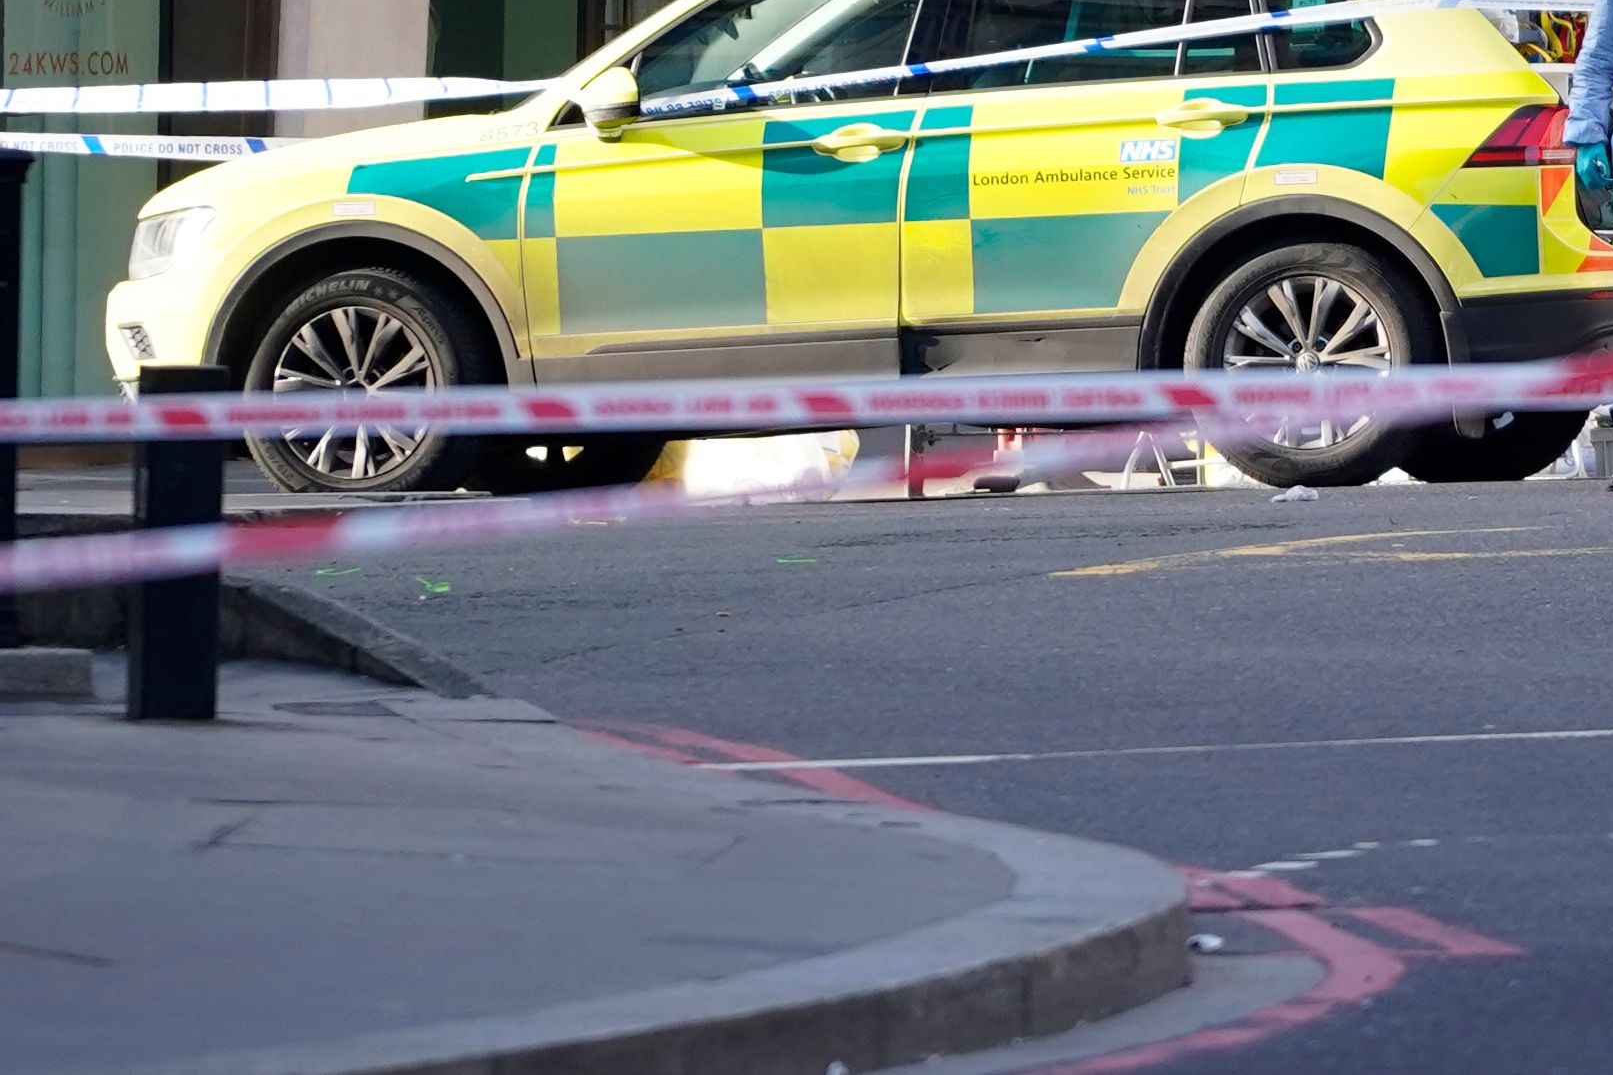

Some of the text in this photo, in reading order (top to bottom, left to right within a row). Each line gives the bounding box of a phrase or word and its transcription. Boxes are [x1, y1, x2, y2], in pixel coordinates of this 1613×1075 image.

[7, 51, 129, 77] 24KWS.COM
[13, 140, 35, 150] NOT
[39, 141, 79, 152] CROSS
[114, 142, 243, 156] POLICE DO NOT CROSS
[1121, 140, 1176, 162] NHS
[973, 165, 1176, 186] London Ambulance Service
[1127, 185, 1176, 195] NHS Trust
